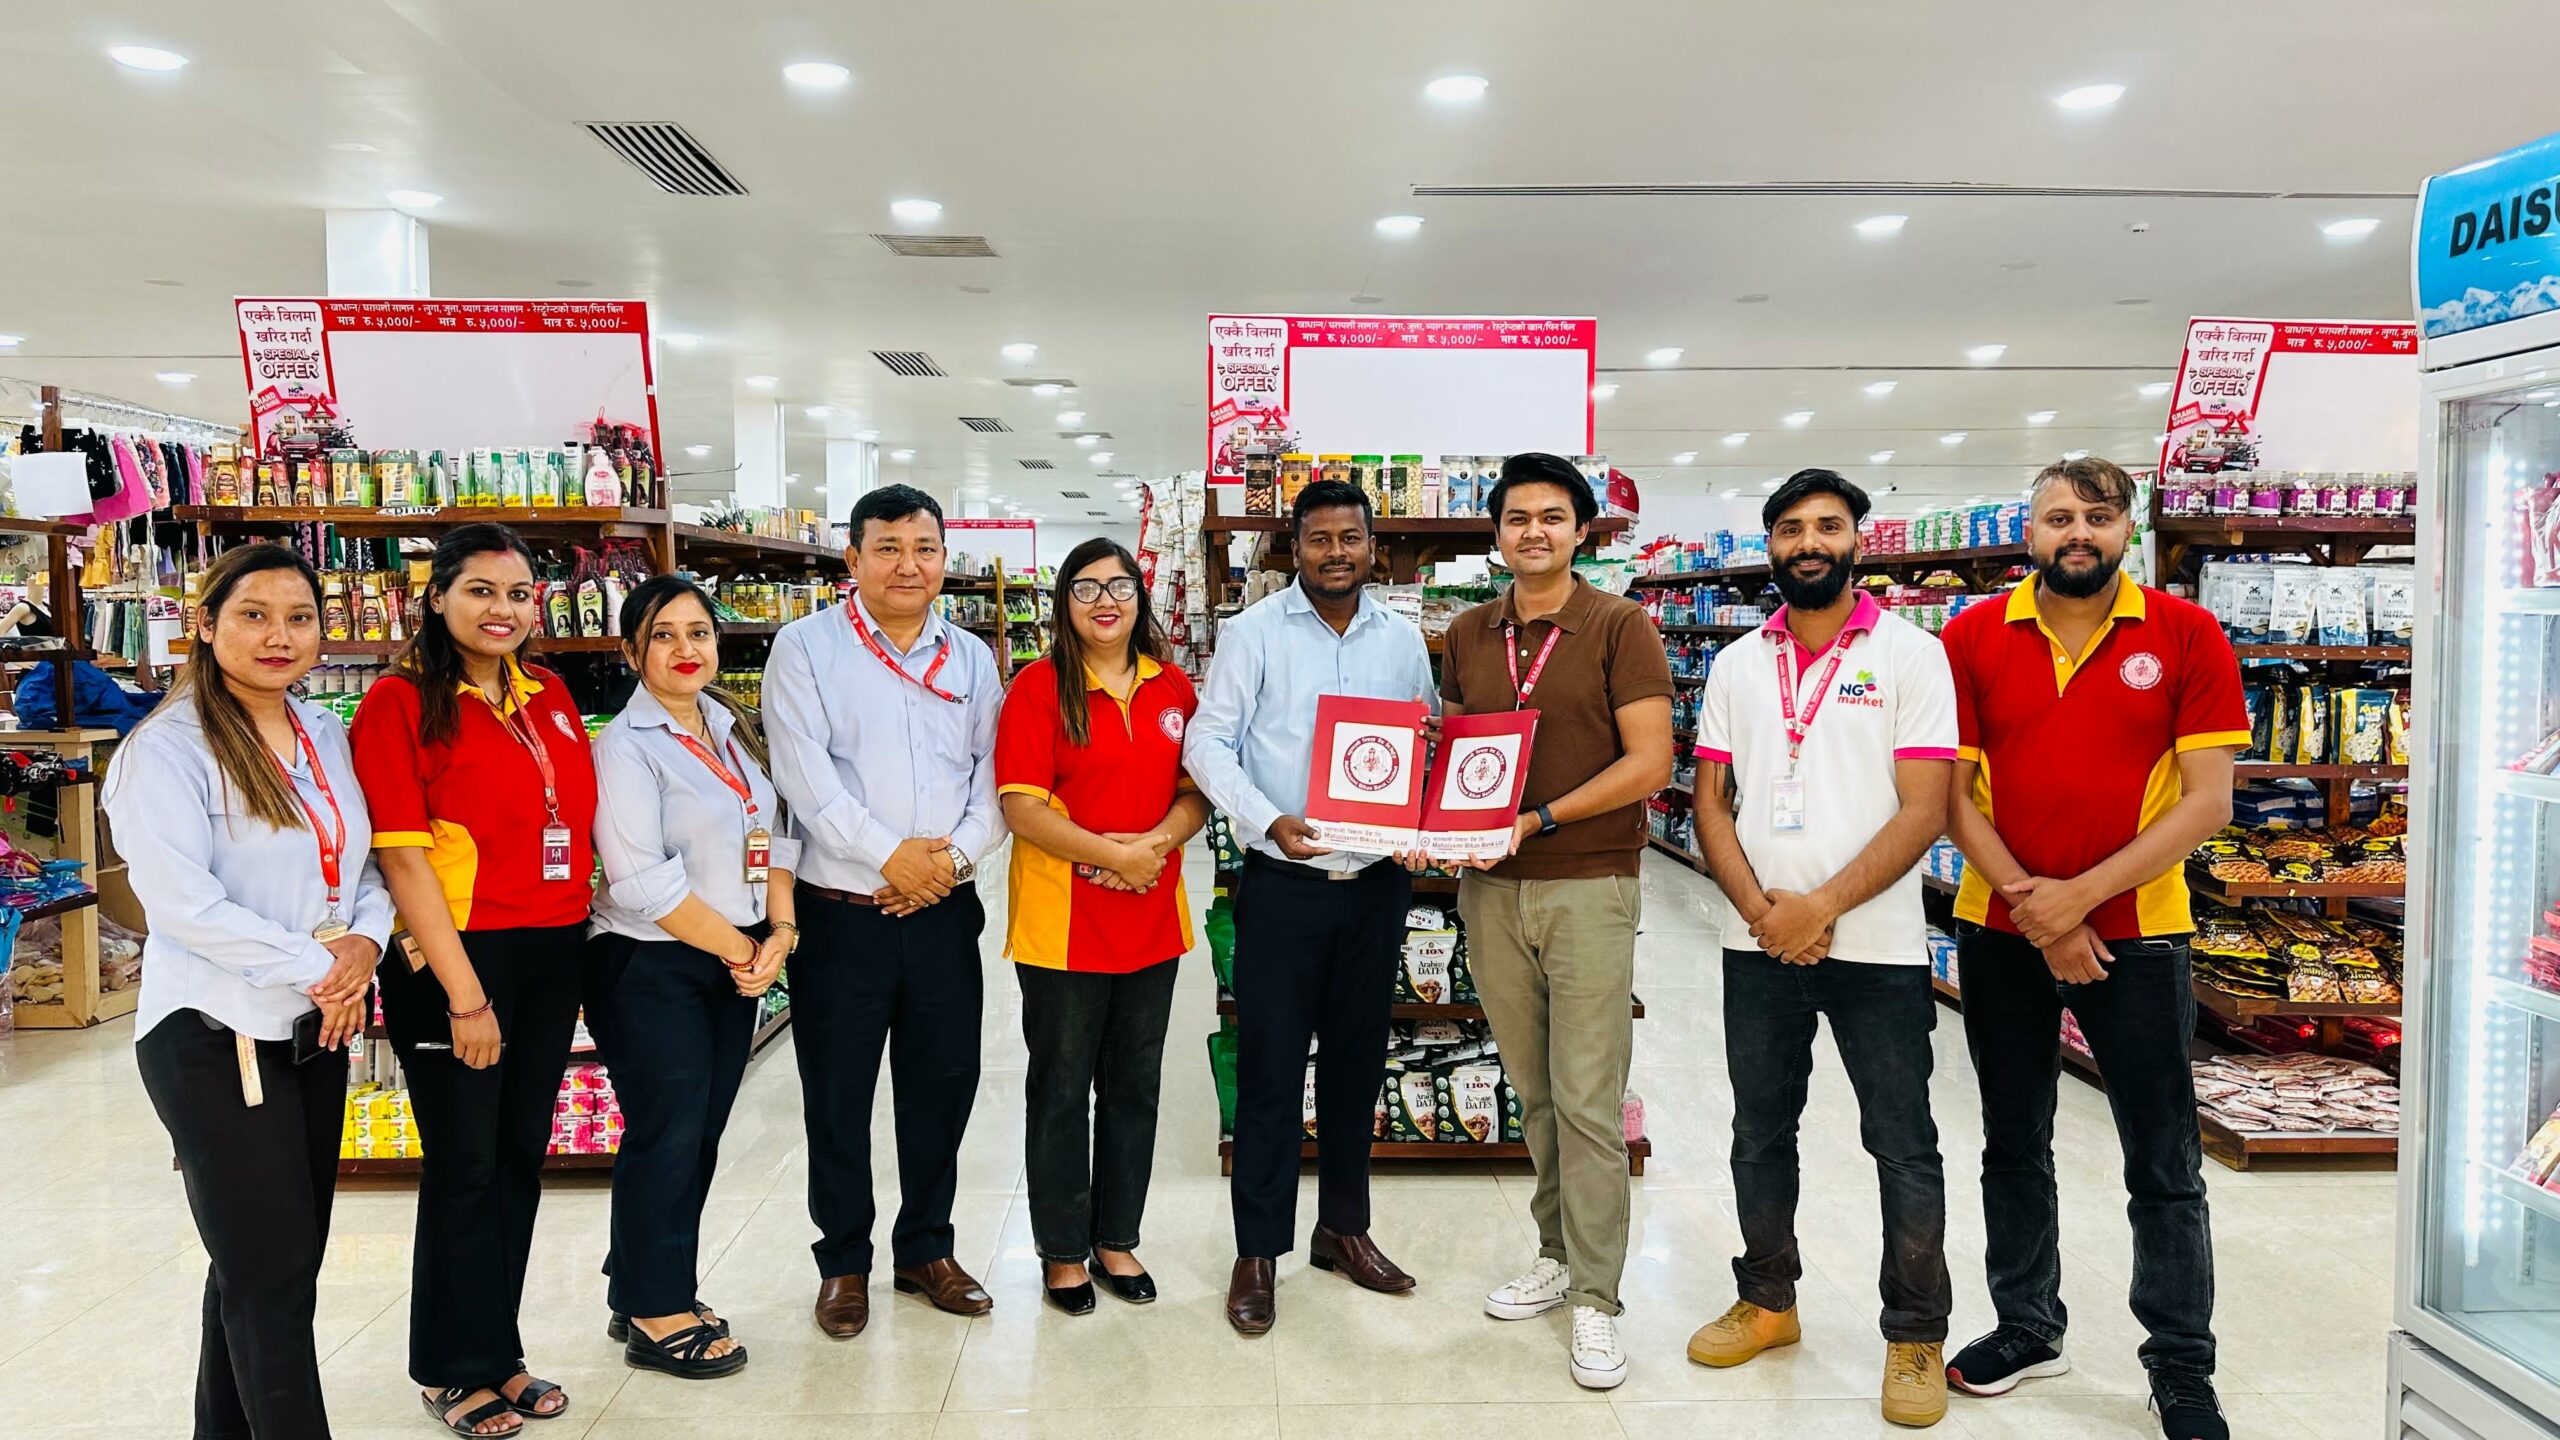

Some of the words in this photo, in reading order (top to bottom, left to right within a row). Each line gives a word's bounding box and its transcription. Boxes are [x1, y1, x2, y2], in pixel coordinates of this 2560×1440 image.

[2449, 182, 2560, 258] DAIS
[263, 349, 310, 361] SPECIAL
[259, 361, 320, 379] OFFER
[1227, 363, 1270, 375] SPECIAL
[2199, 367, 2245, 379] SPECIAL
[1221, 375, 1277, 392] OFFER
[2189, 379, 2248, 396] OFFER
[1838, 683, 1865, 697] NG
[1837, 694, 1884, 708] market
[1418, 967, 1444, 975] DATES
[1419, 960, 1445, 969] Arabian
[1465, 1101, 1492, 1110] DATES
